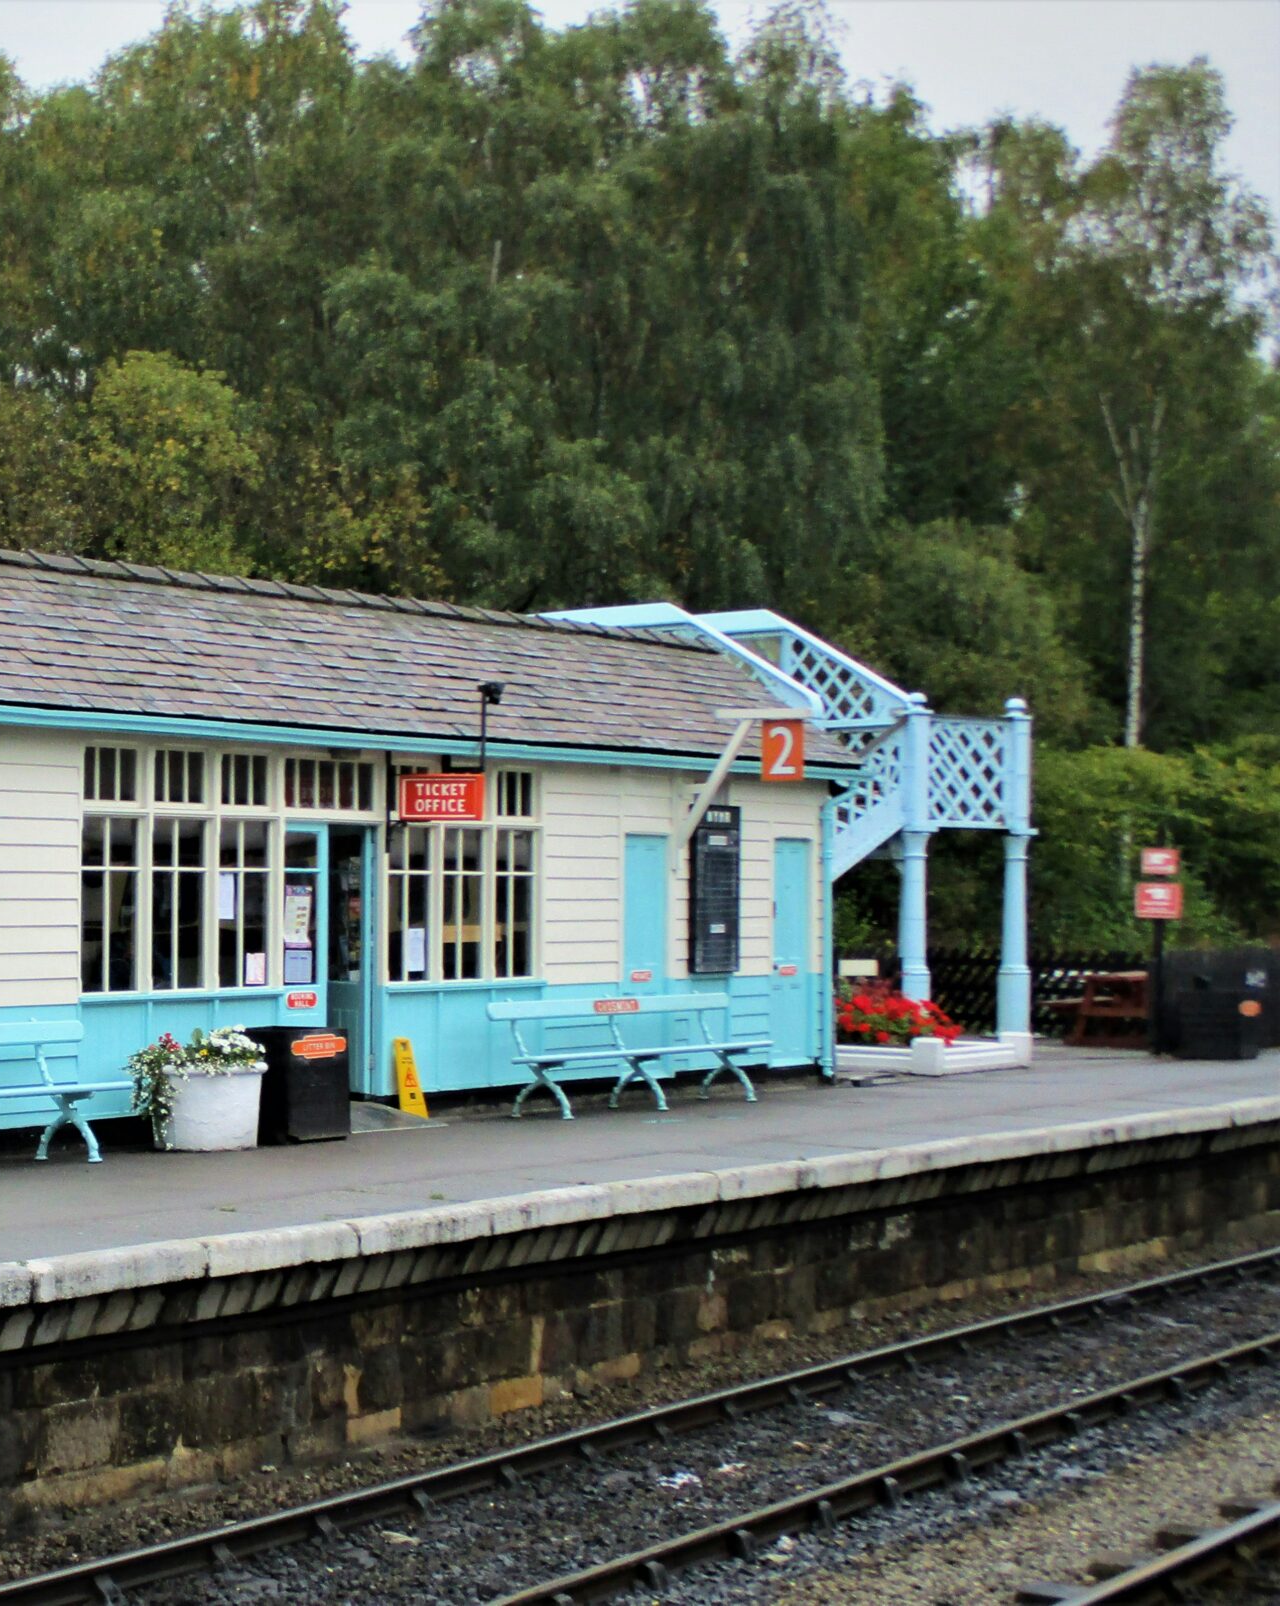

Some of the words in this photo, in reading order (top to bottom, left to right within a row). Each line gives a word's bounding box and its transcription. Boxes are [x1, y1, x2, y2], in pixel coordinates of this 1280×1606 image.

[769, 726, 797, 775] 2
[415, 783, 467, 796] TICKET
[415, 798, 466, 812] OFFICE
